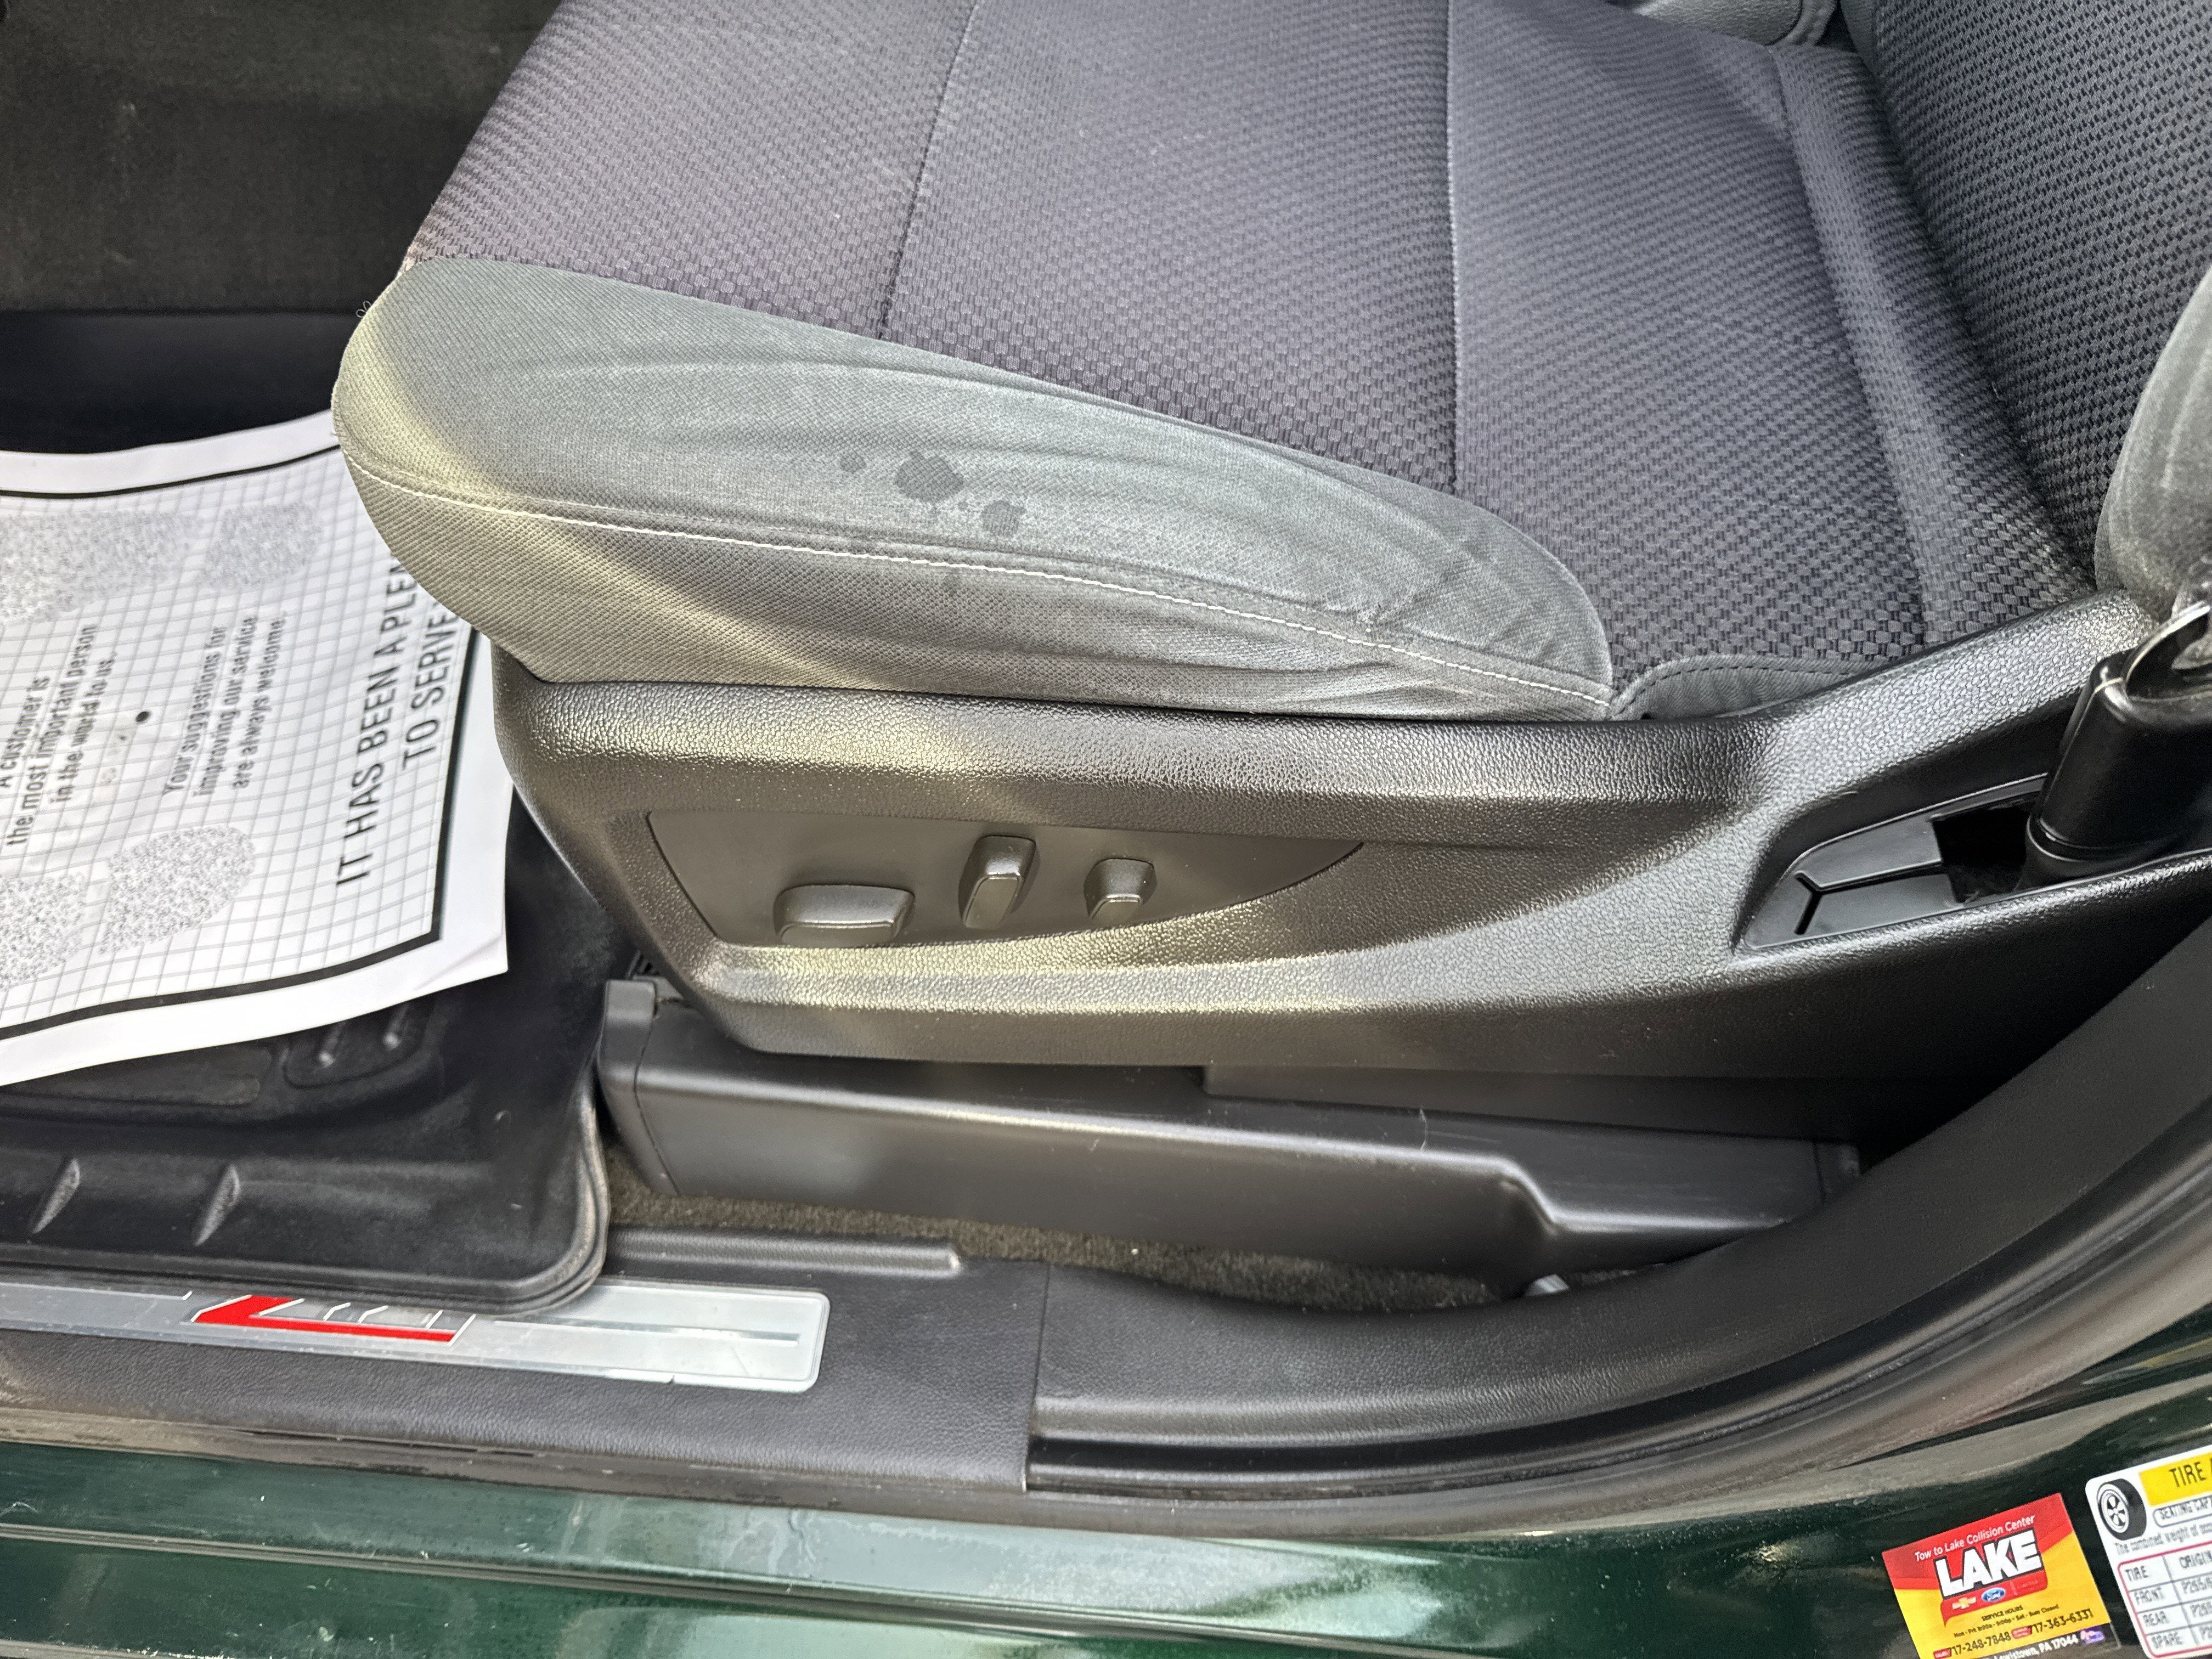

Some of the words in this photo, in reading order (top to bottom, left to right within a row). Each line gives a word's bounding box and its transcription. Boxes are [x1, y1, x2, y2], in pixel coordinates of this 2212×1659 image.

[231, 616, 258, 675] service
[374, 635, 408, 659] A
[411, 612, 461, 710] SERVE
[84, 679, 108, 697] to
[223, 678, 243, 706] our
[2, 695, 43, 770] customer
[26, 676, 50, 692] is
[71, 699, 101, 747] world
[162, 756, 194, 795] Your
[180, 652, 221, 753] suggestions
[204, 627, 227, 650] for
[239, 696, 272, 756] always
[358, 664, 400, 754] BEEN
[7, 815, 33, 846] the
[21, 767, 49, 810] most
[35, 681, 79, 759] important
[66, 624, 98, 678] person
[192, 709, 240, 797] improving
[402, 719, 439, 770] TO
[58, 750, 83, 781] the
[232, 760, 255, 789] are
[49, 785, 74, 803] in
[343, 763, 385, 839] HAS
[335, 853, 373, 885] IT
[2169, 1461, 2207, 1487] TIRE
[1914, 1549, 1932, 1562] Tow
[1933, 1546, 1944, 1555] to
[1944, 1538, 1965, 1552] Lake
[1966, 1526, 2004, 1543] Collision
[2005, 1515, 2036, 1532] Center
[1934, 1527, 2044, 1599] LAKE
[2124, 1565, 2148, 1582] TIRE
[2134, 1586, 2165, 1605] FRONT
[2143, 1611, 2170, 1628] REAR
[2038, 1642, 2053, 1653] PA
[2151, 1632, 2182, 1649] SPARE
